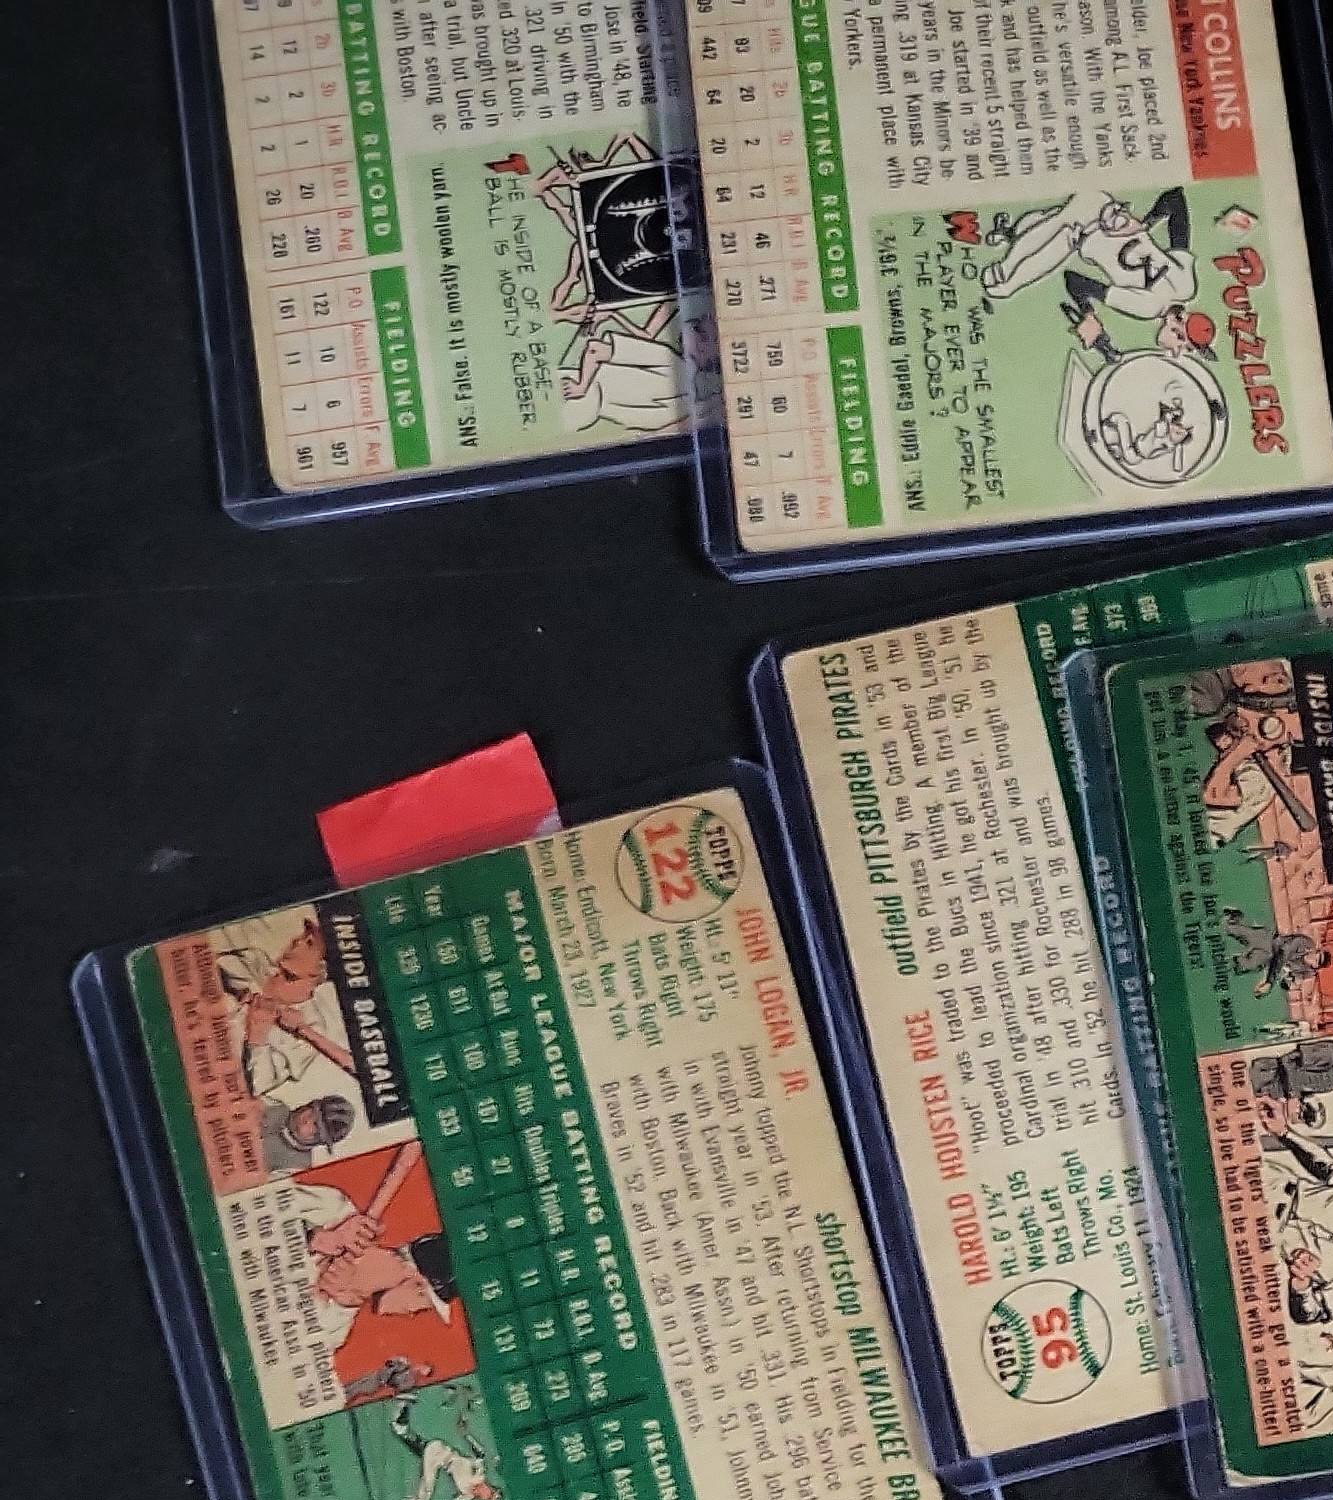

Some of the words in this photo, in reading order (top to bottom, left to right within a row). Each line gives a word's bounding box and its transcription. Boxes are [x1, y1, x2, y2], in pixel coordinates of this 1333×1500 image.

[847, 11, 860, 70] Yorkers.
[1204, 14, 1240, 132] COLLINS
[361, 131, 392, 237] RECORD
[805, 62, 833, 180] BATTING
[822, 194, 848, 301] RECORD
[914, 253, 931, 292] THE
[940, 242, 956, 316] PLAYER
[381, 302, 416, 429] FIELDING
[945, 325, 962, 371] EVER
[968, 307, 985, 344] WAS
[952, 385, 967, 413] TO
[973, 360, 991, 397] THE
[837, 360, 868, 490] FIELDING
[957, 428, 979, 506] APPEAR
[978, 408, 1004, 500] SMALLEST
[819, 653, 861, 740] PIRATES
[1306, 675, 1331, 748] INSIDE
[847, 751, 892, 885] PITTSBURGH
[643, 821, 697, 906] 122
[881, 893, 919, 977] outfield
[329, 915, 366, 985] INSIDE
[352, 998, 399, 1109] BASEBALL
[737, 907, 766, 964] JOHN
[753, 973, 794, 1053] LOGAN,
[904, 1010, 938, 1062] RICE
[504, 889, 540, 979] MAJOR
[532, 995, 574, 1099] LEAGUE
[556, 1109, 602, 1224] BATTING
[594, 1237, 639, 1351] RECORD
[920, 1075, 966, 1181] HOUSTEN
[1061, 1149, 1088, 1195] Right
[950, 1192, 992, 1286] HAROLD
[1076, 1195, 1101, 1260] Throws
[815, 1212, 862, 1316] shortstop
[850, 1326, 908, 1465] MILWAUKEE
[1034, 1308, 1078, 1369] 95
